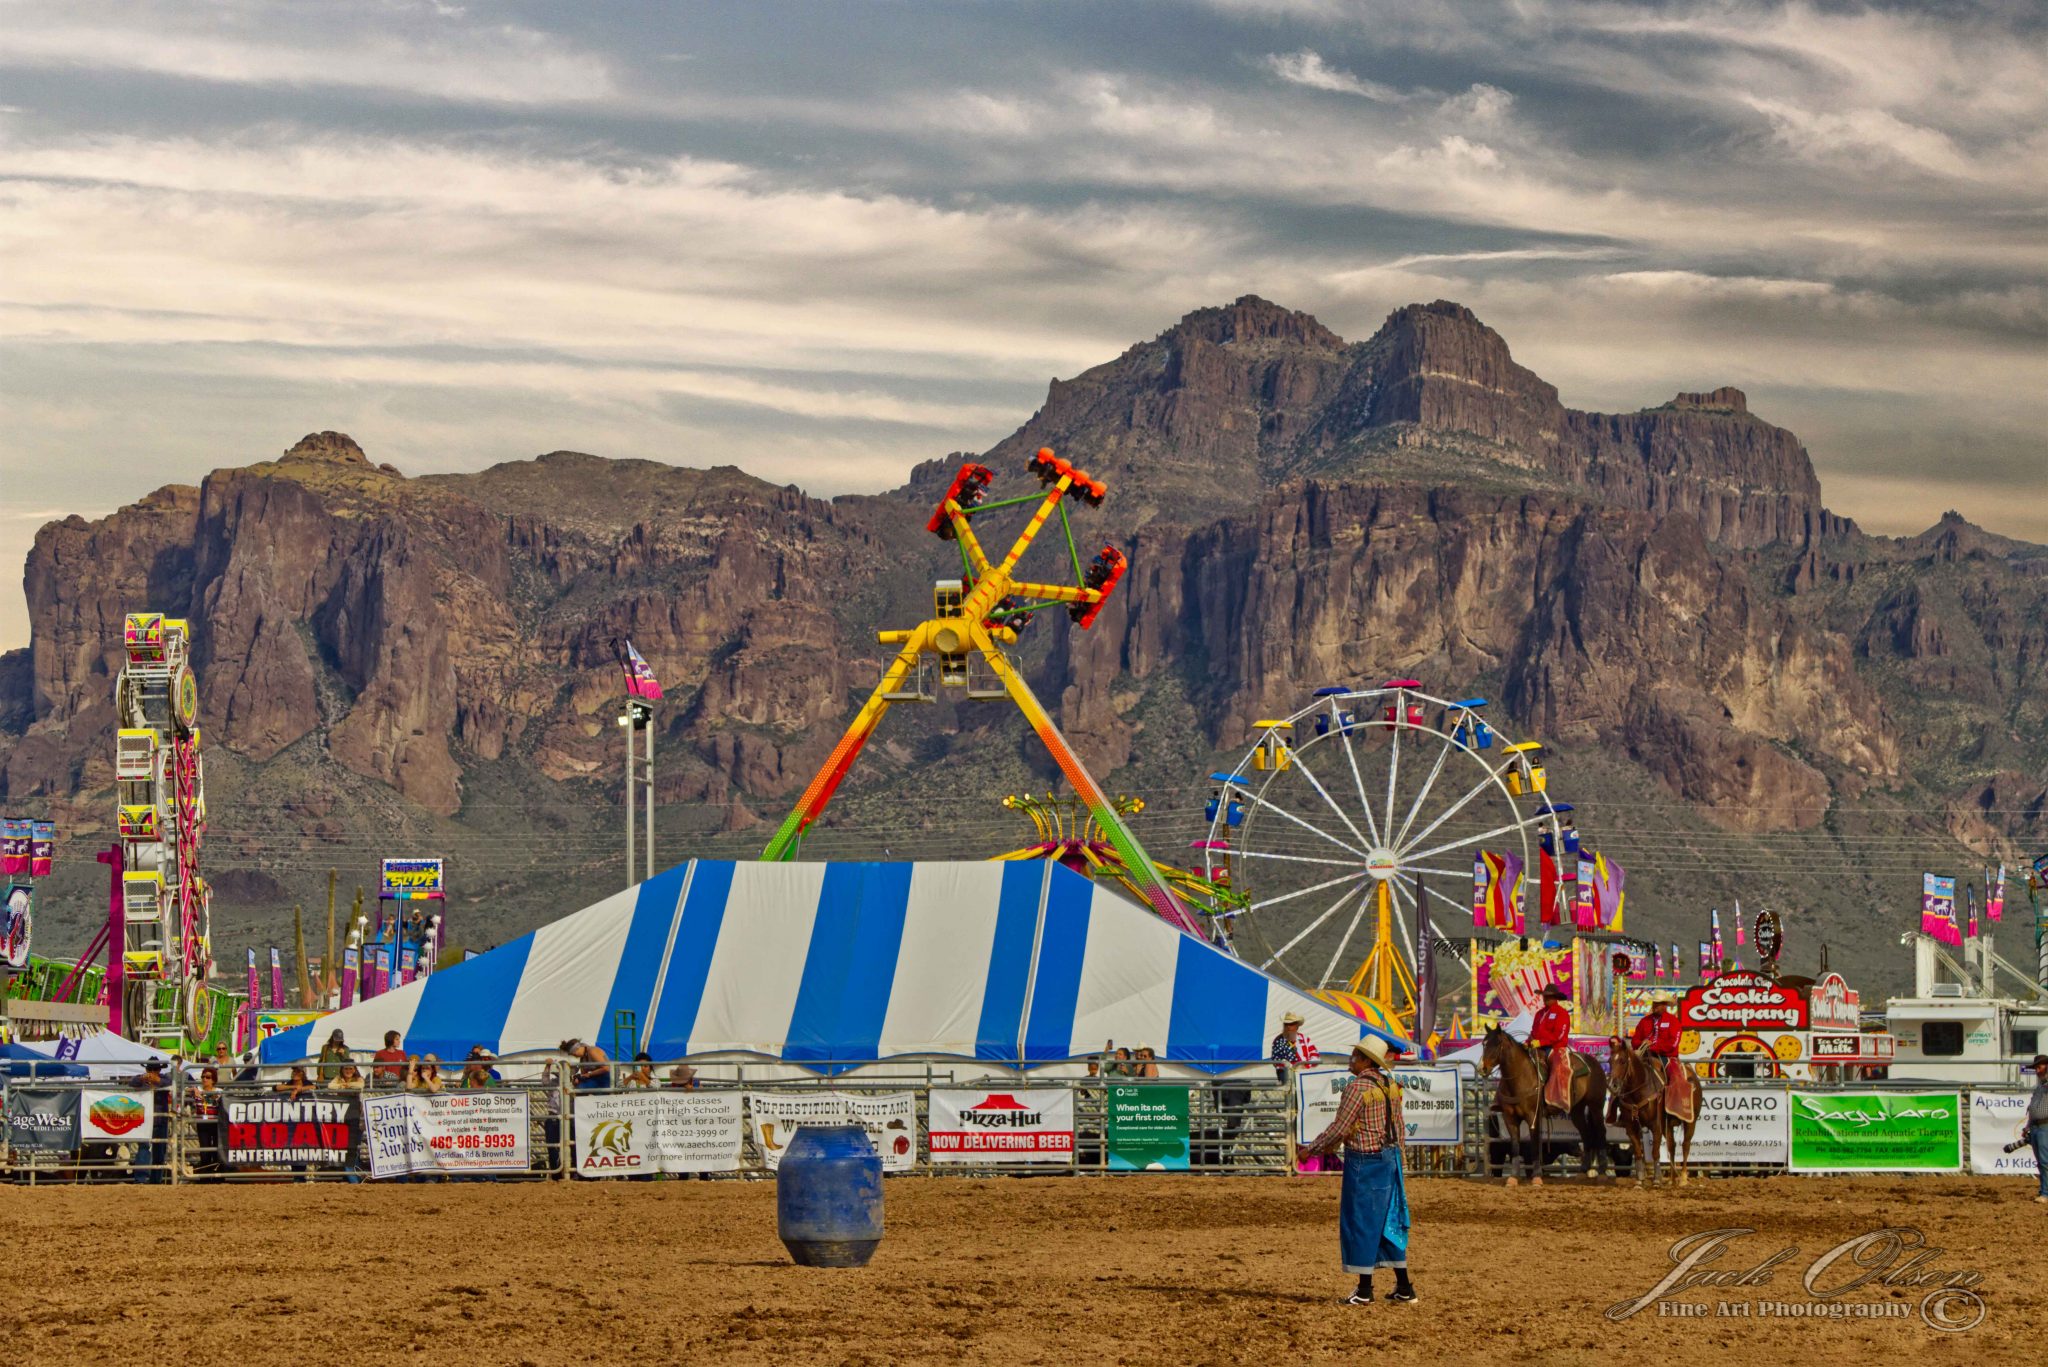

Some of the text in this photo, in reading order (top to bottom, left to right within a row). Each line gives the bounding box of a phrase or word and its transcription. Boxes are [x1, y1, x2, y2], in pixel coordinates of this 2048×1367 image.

[1418, 930, 1429, 974] LIGHT
[1714, 974, 1772, 990] Chocolate Chip
[1701, 988, 1786, 1005] Cookie
[1688, 1004, 1799, 1027] Company
[1818, 1044, 1854, 1054] Milk
[430, 1096, 516, 1108] Your ONE Stop Shop
[595, 1097, 723, 1109] Take FREE college classes
[755, 1099, 908, 1115] SUPERSTITION MOUNTAIN
[1700, 1097, 1777, 1110] AGUARO
[1975, 1096, 2024, 1109] Apache
[228, 1101, 350, 1123] COUNTRY
[372, 1103, 415, 1121] Divine
[587, 1110, 614, 1119] while
[616, 1110, 635, 1119] you
[656, 1107, 664, 1115] in
[667, 1106, 691, 1117] High
[693, 1106, 730, 1114] School!
[960, 1110, 1042, 1127] Pizza Hut
[1135, 1113, 1152, 1121] first
[1153, 1113, 1178, 1121] rodeo.
[1795, 1098, 1950, 1128] Saguaro
[13, 1113, 72, 1129] ageWest
[412, 1121, 421, 1134] &
[646, 1118, 678, 1126] Contact
[695, 1117, 708, 1125] for
[717, 1117, 737, 1125] Tour
[228, 1122, 350, 1149] ROAD
[661, 1129, 717, 1138] 480-222-3999
[1795, 1128, 1954, 1138] Rehabilitation and Aquatic Therapy
[379, 1137, 424, 1159] Awards
[430, 1134, 515, 1149] 480-986-9933
[645, 1140, 736, 1149] visit www.aaechs.com
[931, 1135, 1071, 1149] NOW DELIVERING BEER
[228, 1149, 348, 1162] ENTERTAINMENT
[583, 1155, 641, 1168] AAEC
[647, 1153, 658, 1161] for
[684, 1152, 732, 1161] information
[1995, 1158, 2038, 1169] AJ Kids
